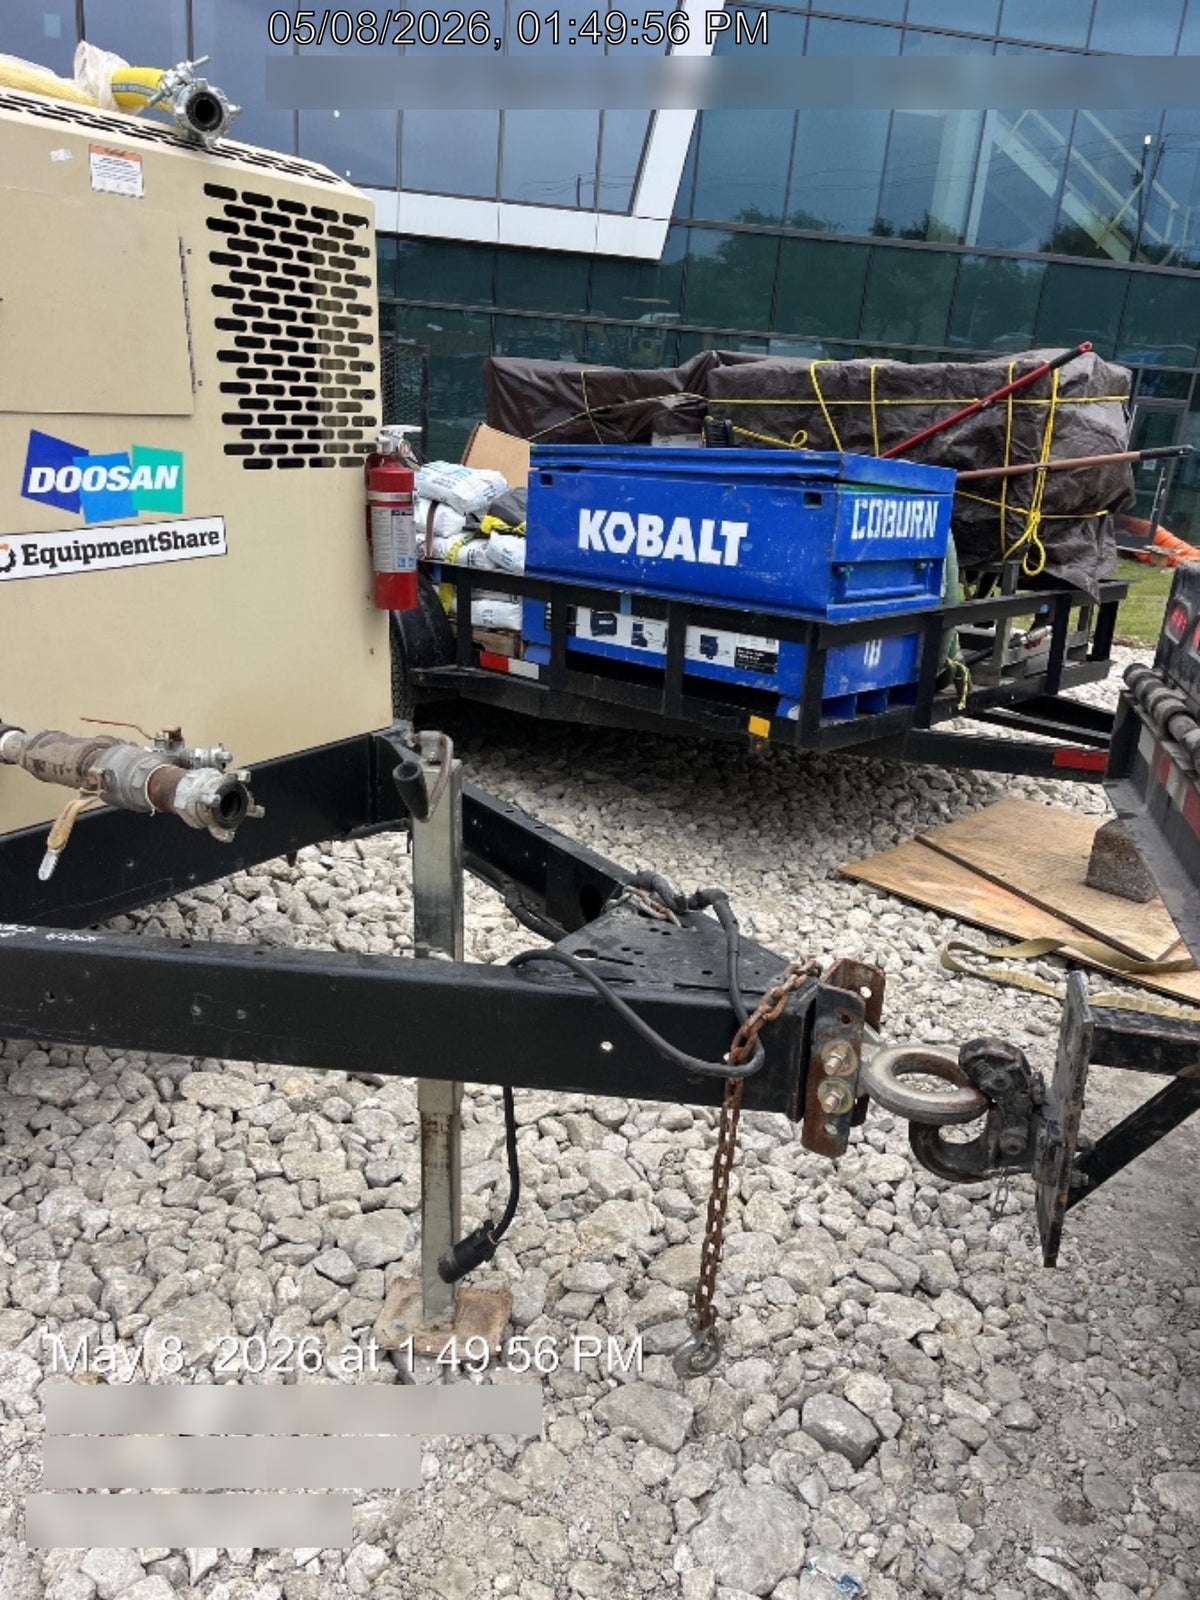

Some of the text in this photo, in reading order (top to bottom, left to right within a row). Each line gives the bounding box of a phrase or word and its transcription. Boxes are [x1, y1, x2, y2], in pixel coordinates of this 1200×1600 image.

[27, 465, 180, 494] DOOSAN
[578, 508, 748, 566] KOBALT
[851, 499, 940, 540] COBURN
[21, 531, 220, 569] EquipmentShare
